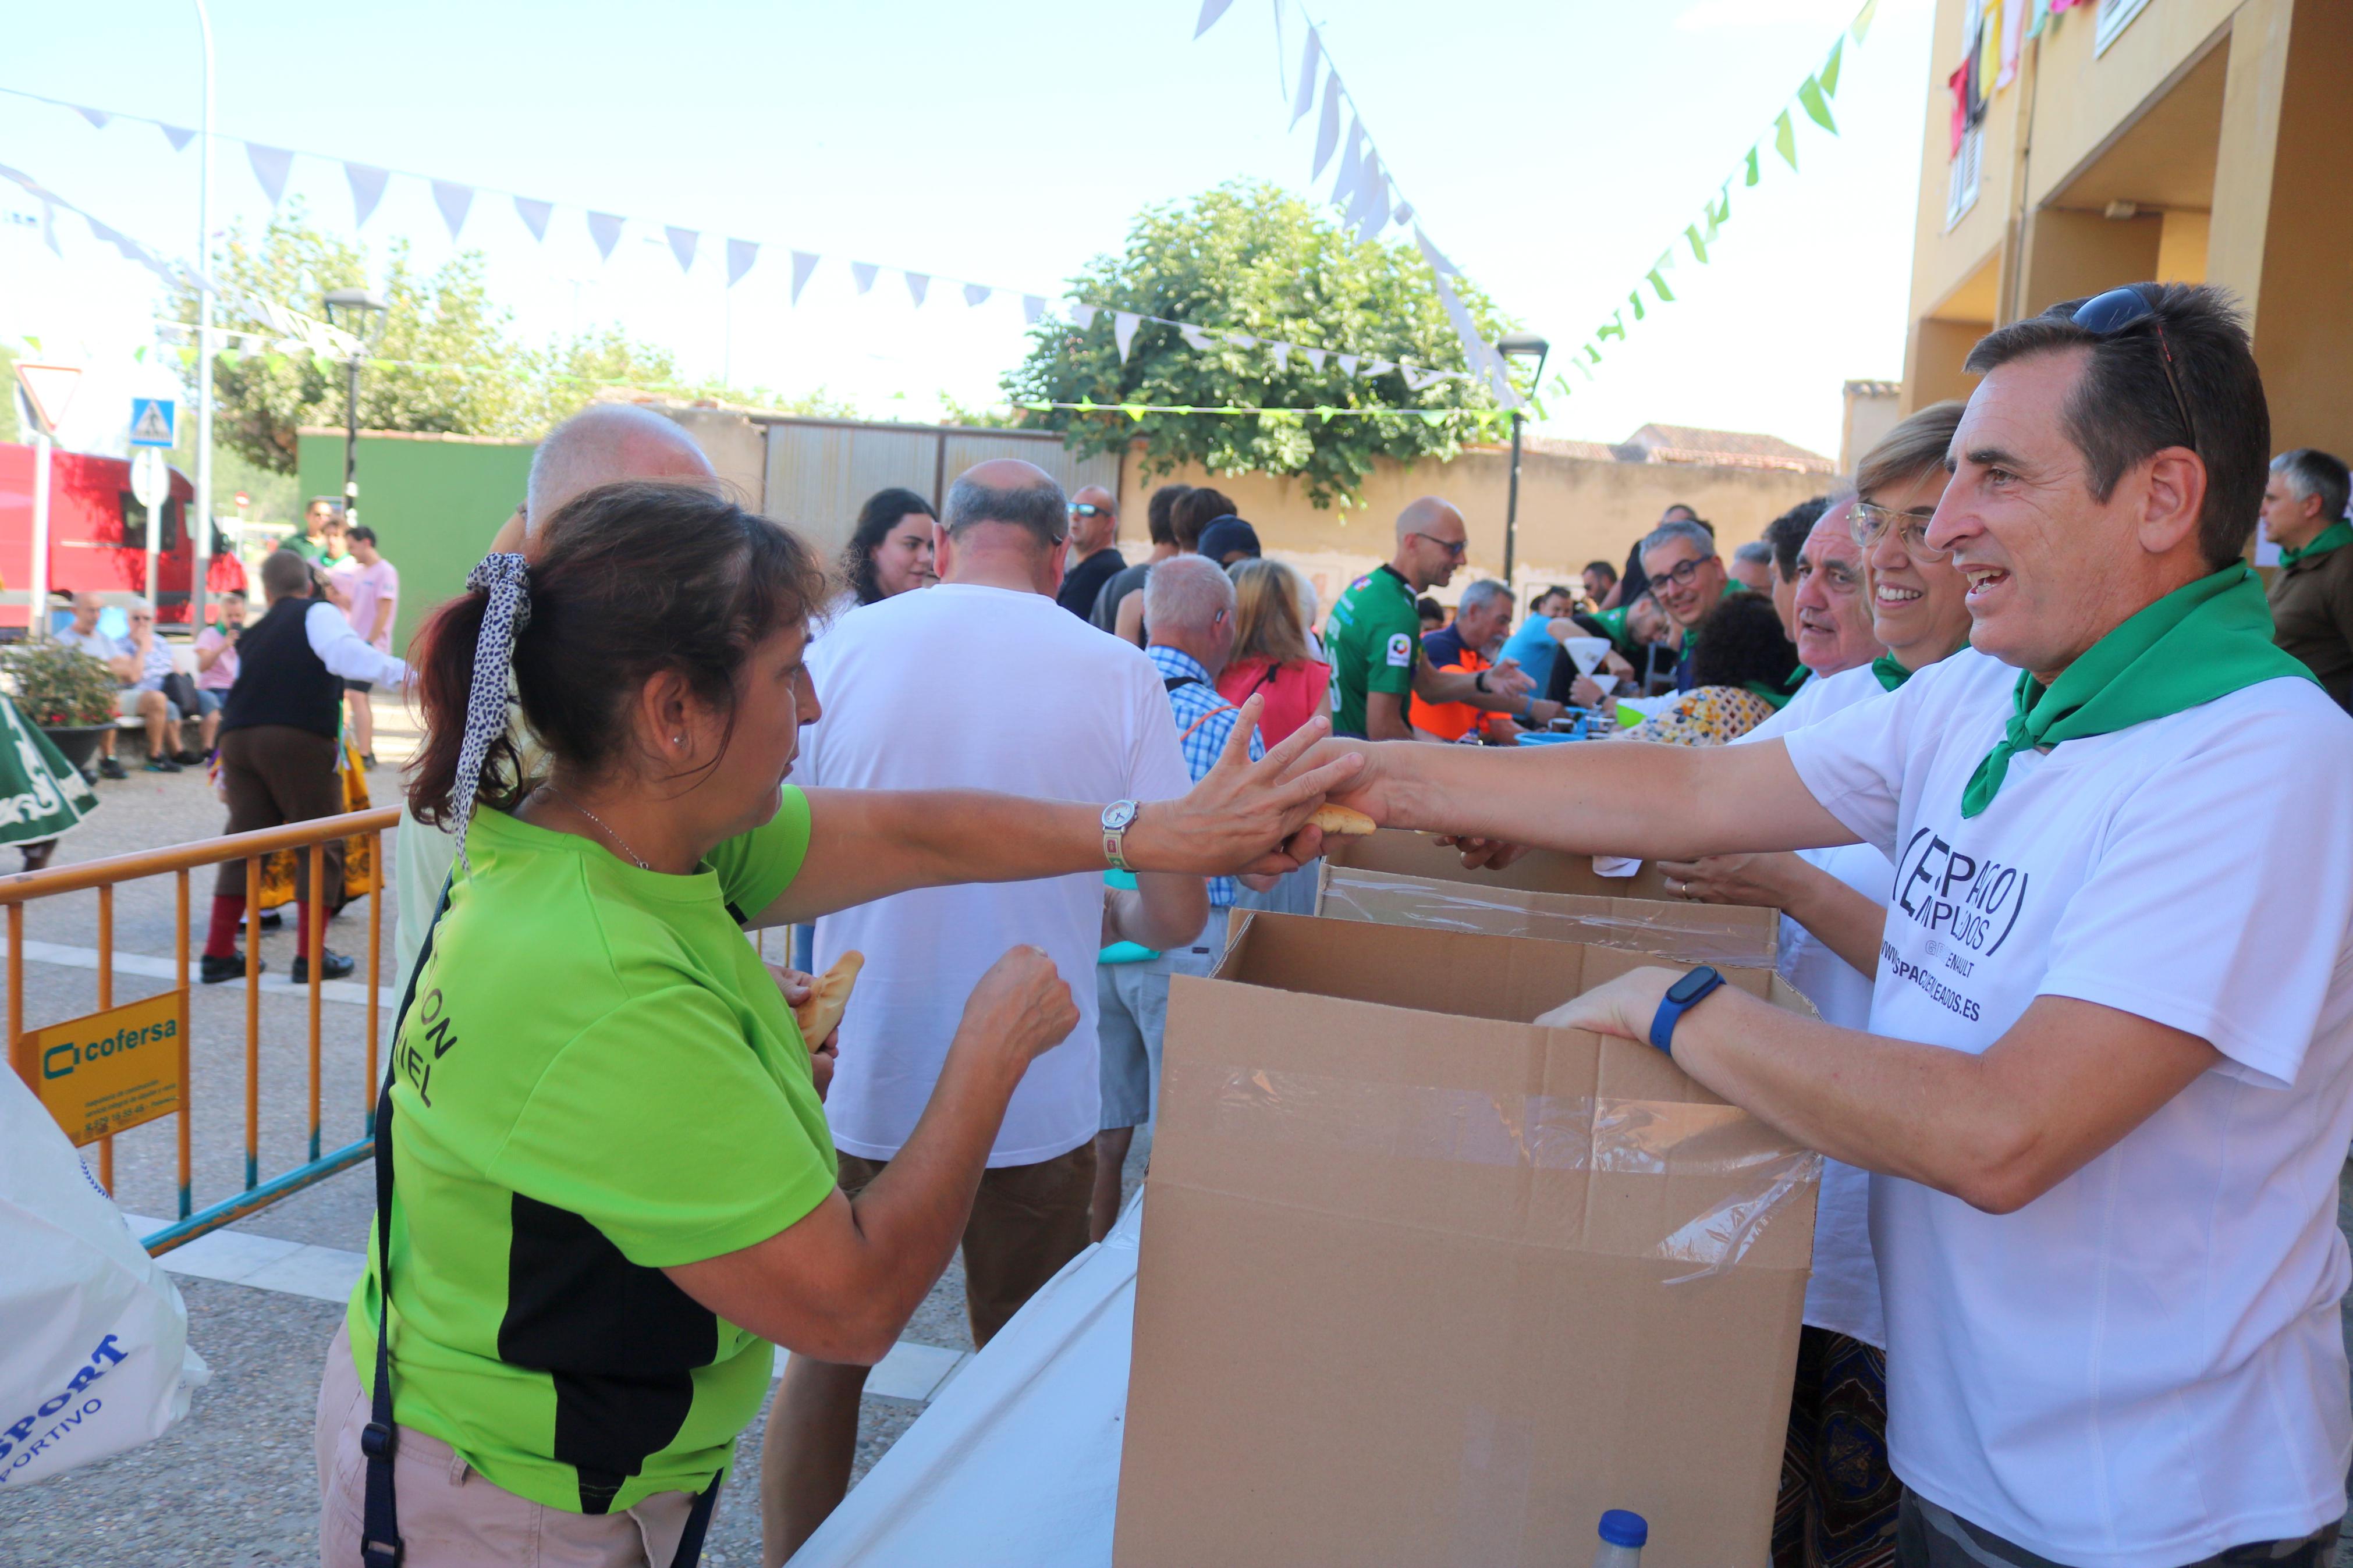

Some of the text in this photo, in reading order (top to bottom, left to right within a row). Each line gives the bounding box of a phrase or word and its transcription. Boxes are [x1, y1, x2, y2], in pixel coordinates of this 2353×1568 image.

[1944, 952, 1975, 978] ENAULT
[85, 1019, 177, 1061] cofersa
[420, 987, 457, 1060] ON
[0, 1399, 102, 1482] PORTIVO
